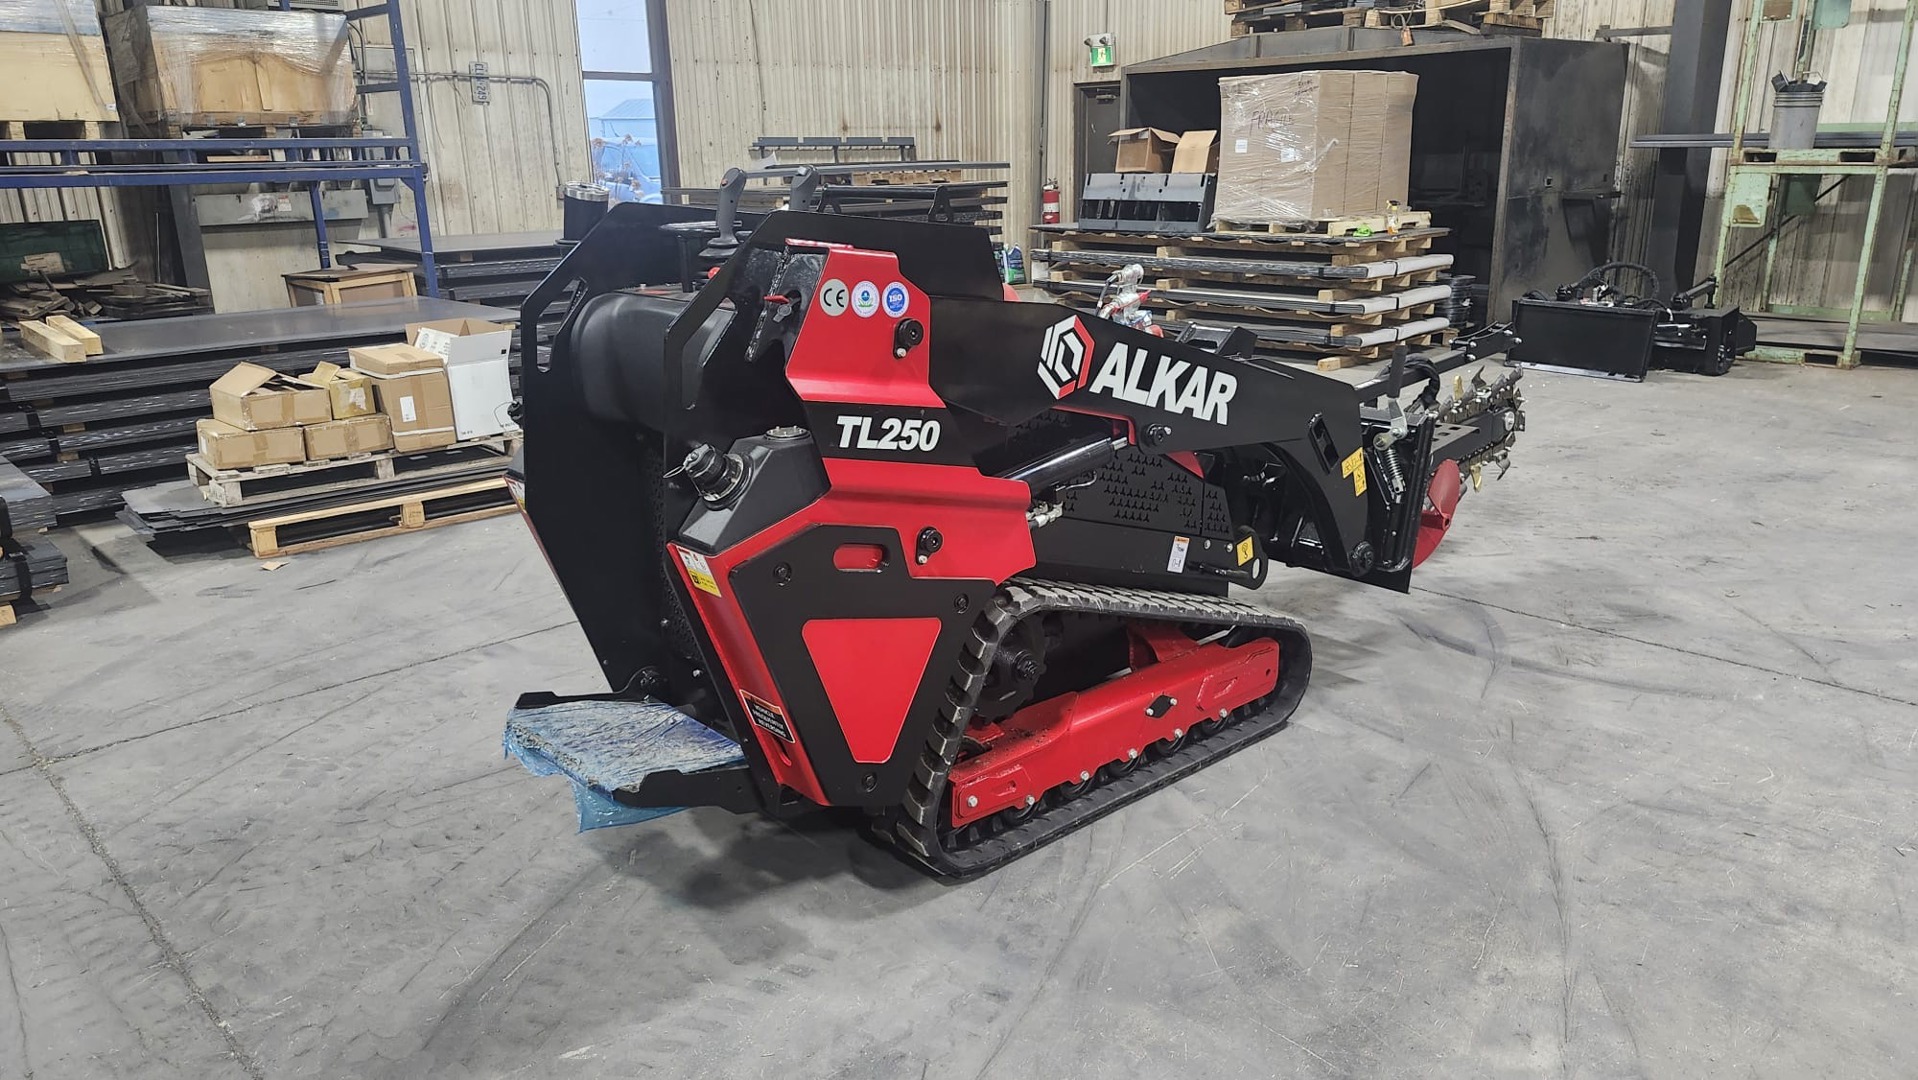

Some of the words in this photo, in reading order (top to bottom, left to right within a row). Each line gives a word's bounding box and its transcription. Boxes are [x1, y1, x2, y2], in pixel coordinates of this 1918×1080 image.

[823, 288, 845, 308] CE
[1089, 341, 1238, 425] ALKAR
[836, 415, 941, 452] TL250
